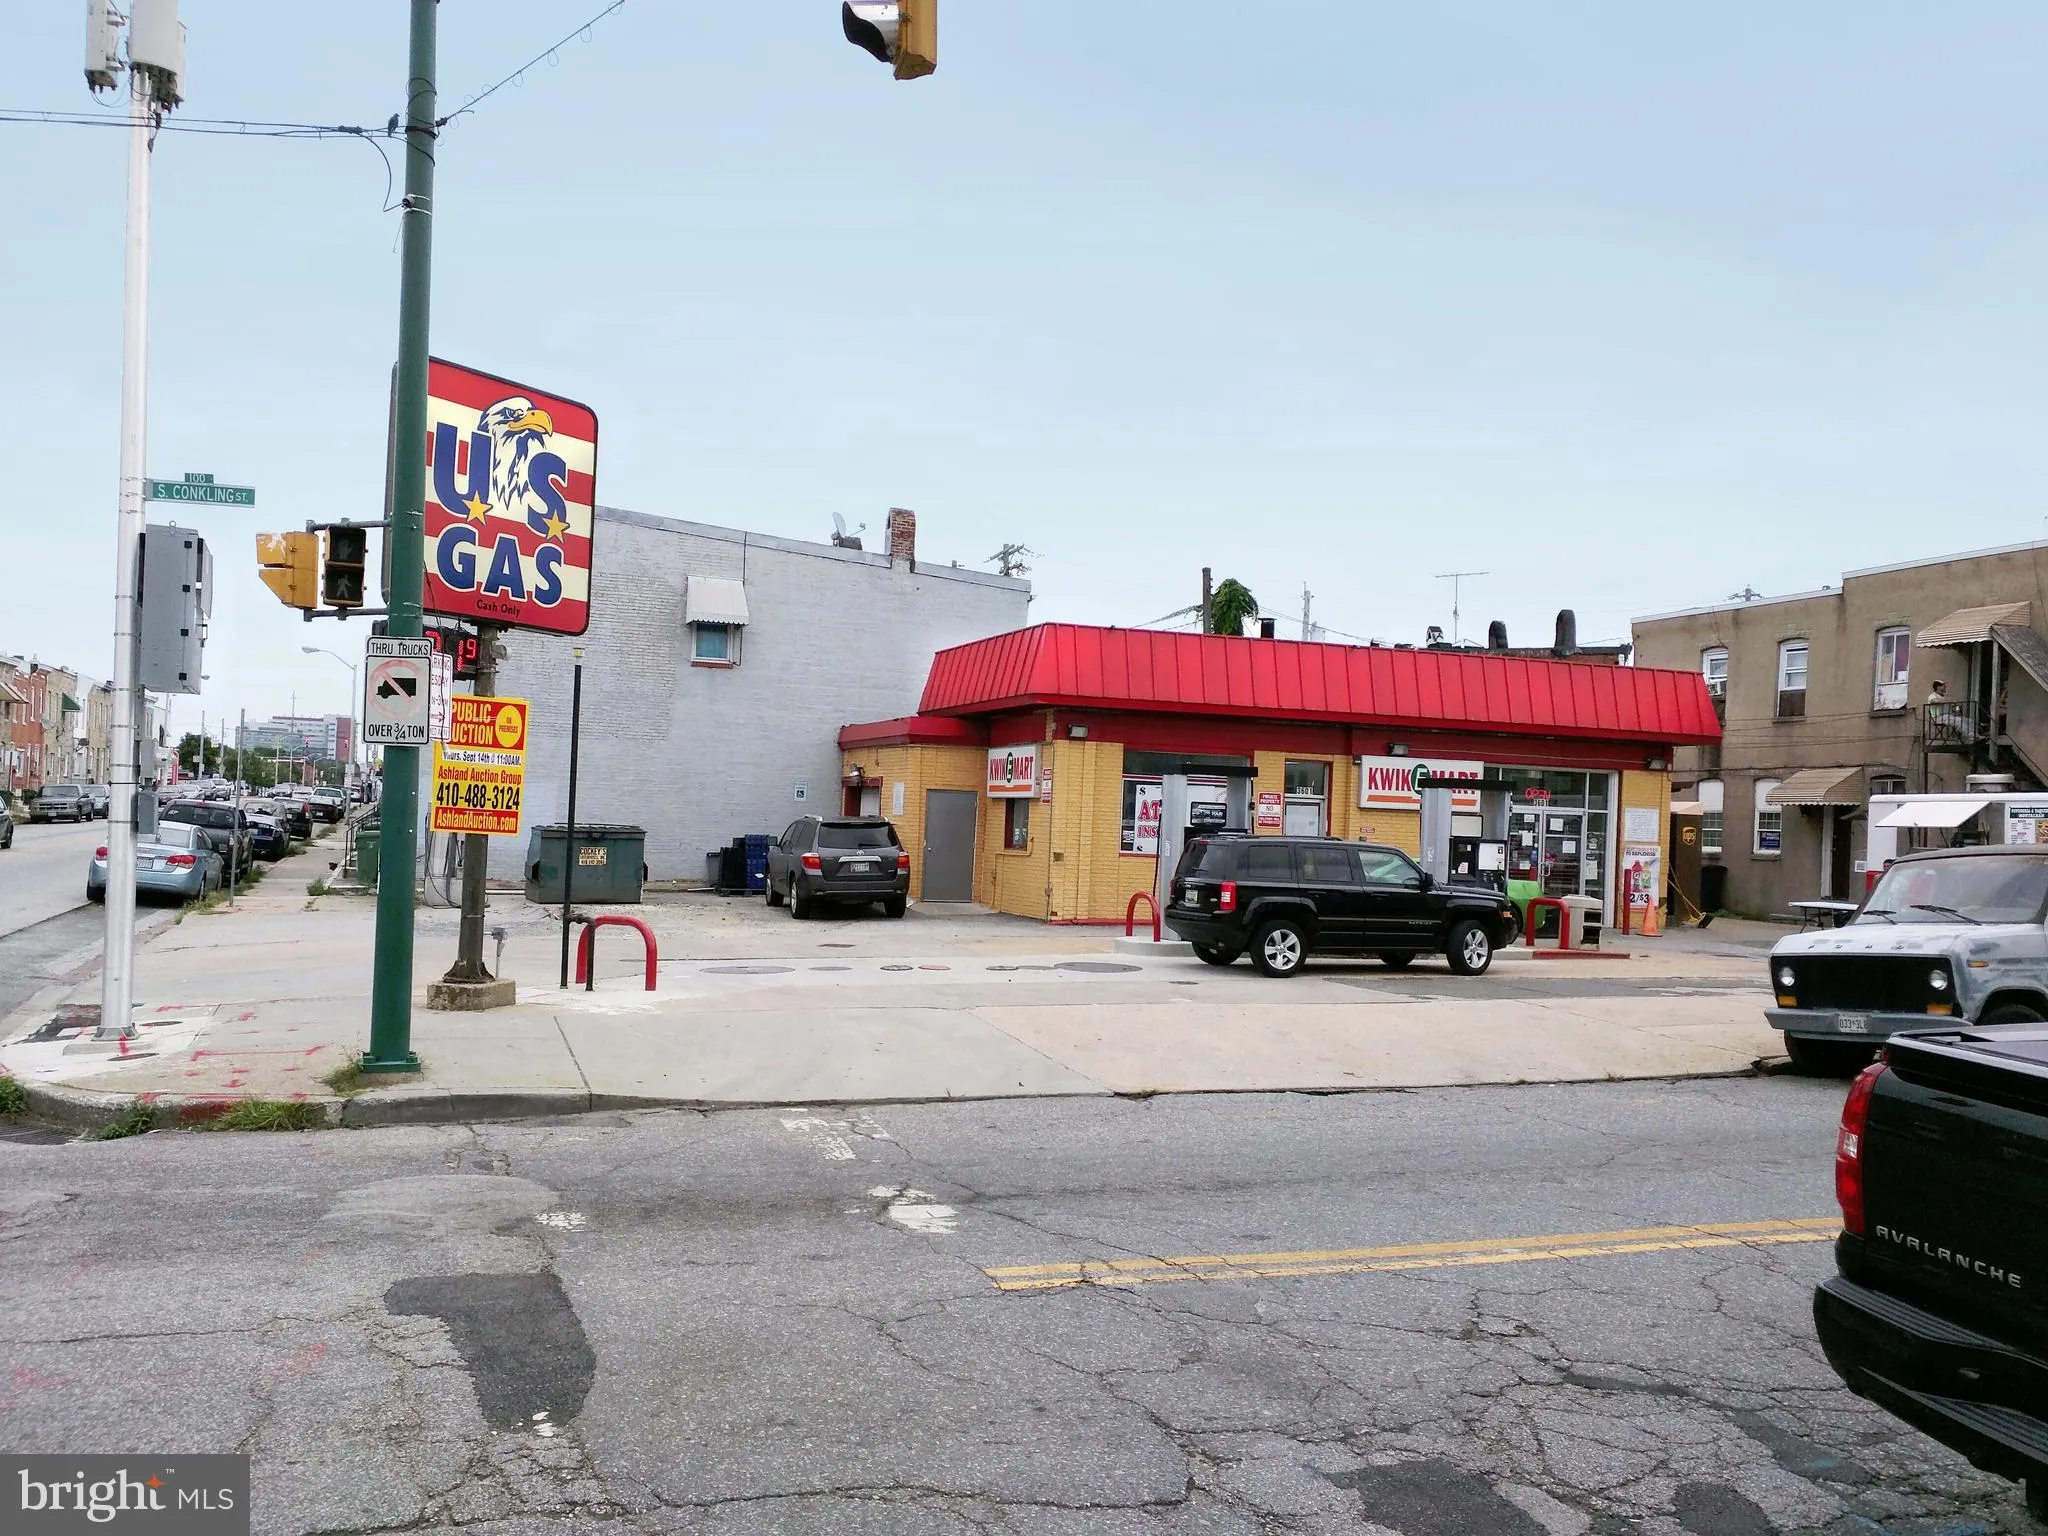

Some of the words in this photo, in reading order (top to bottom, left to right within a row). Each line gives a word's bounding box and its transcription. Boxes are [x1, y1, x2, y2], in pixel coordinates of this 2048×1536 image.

[158, 483, 168, 498] S.
[173, 485, 234, 502] CONKLING
[235, 492, 248, 502] ST.
[437, 526, 563, 605] GAS
[476, 599, 498, 612] Cash
[501, 603, 521, 618] Only
[371, 642, 394, 655] THRU
[398, 642, 429, 656] TRUCKS
[452, 701, 492, 724] PUBLIC
[368, 723, 393, 737] OVER
[407, 725, 425, 738] TON
[452, 722, 493, 745] UCTION
[462, 751, 476, 763] Sept
[478, 752, 490, 764] 14th
[1013, 756, 1033, 780] MART
[437, 765, 469, 781] Ashland
[470, 767, 498, 783] Auction
[500, 770, 522, 786] Group
[1368, 767, 1412, 792] KWIK
[436, 782, 520, 810] 410-488-3124
[436, 808, 517, 831] AshlandAuction.com
[1138, 800, 1161, 822] AT
[1684, 832, 1696, 843] ups
[1876, 1225, 2022, 1288] AVALANCHE
